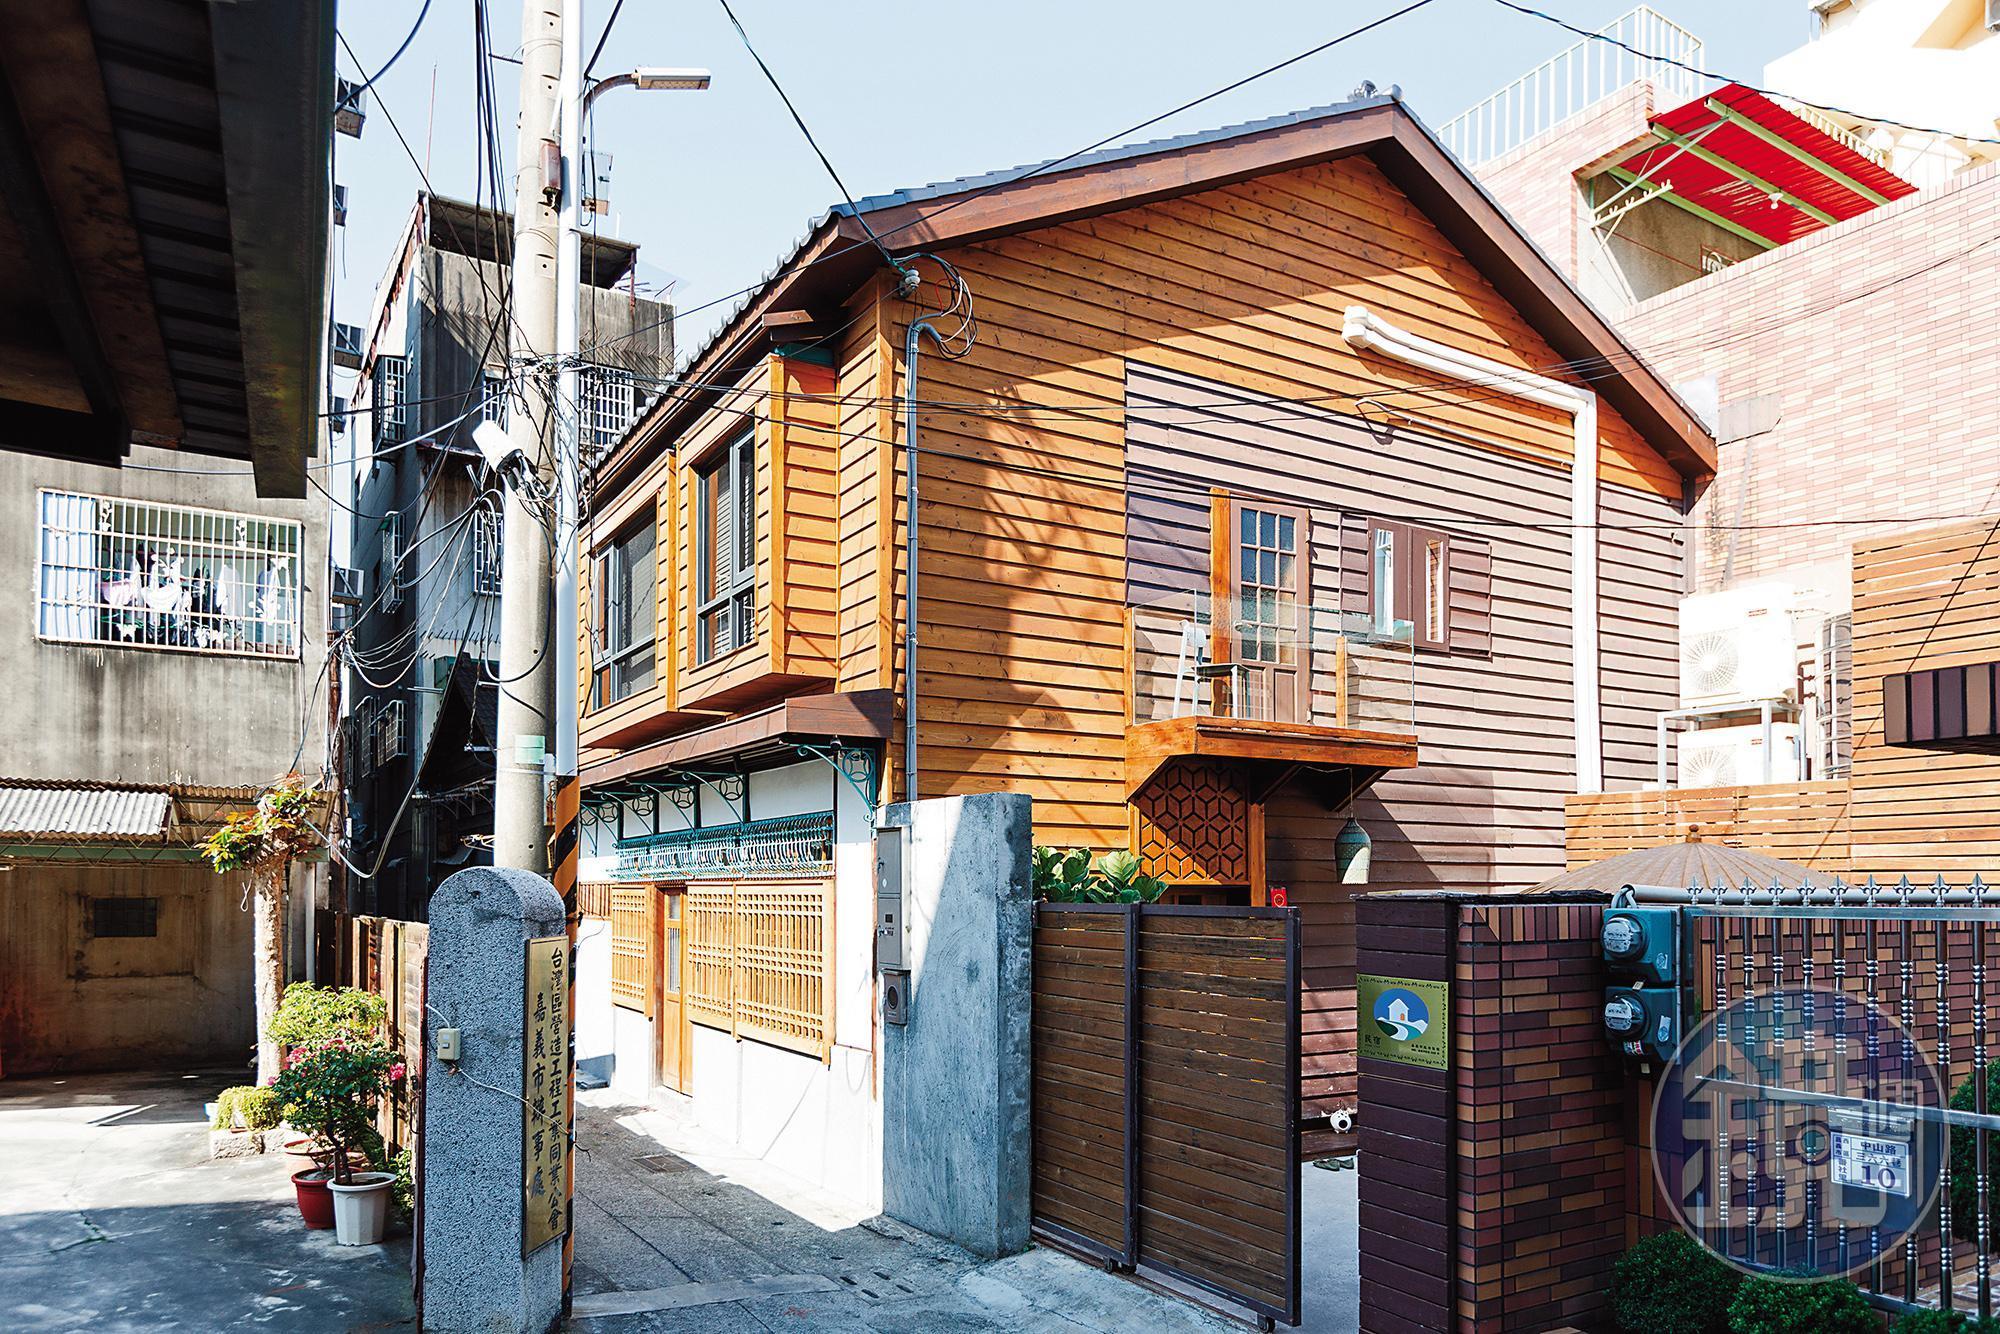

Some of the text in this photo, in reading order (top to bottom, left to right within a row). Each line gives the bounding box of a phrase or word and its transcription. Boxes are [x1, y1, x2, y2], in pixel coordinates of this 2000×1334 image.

[547, 946, 563, 1231] 台灣區營造工程工業同業公會
[1860, 1141, 1897, 1155] 中山路
[1860, 1165, 1896, 1189] 10
